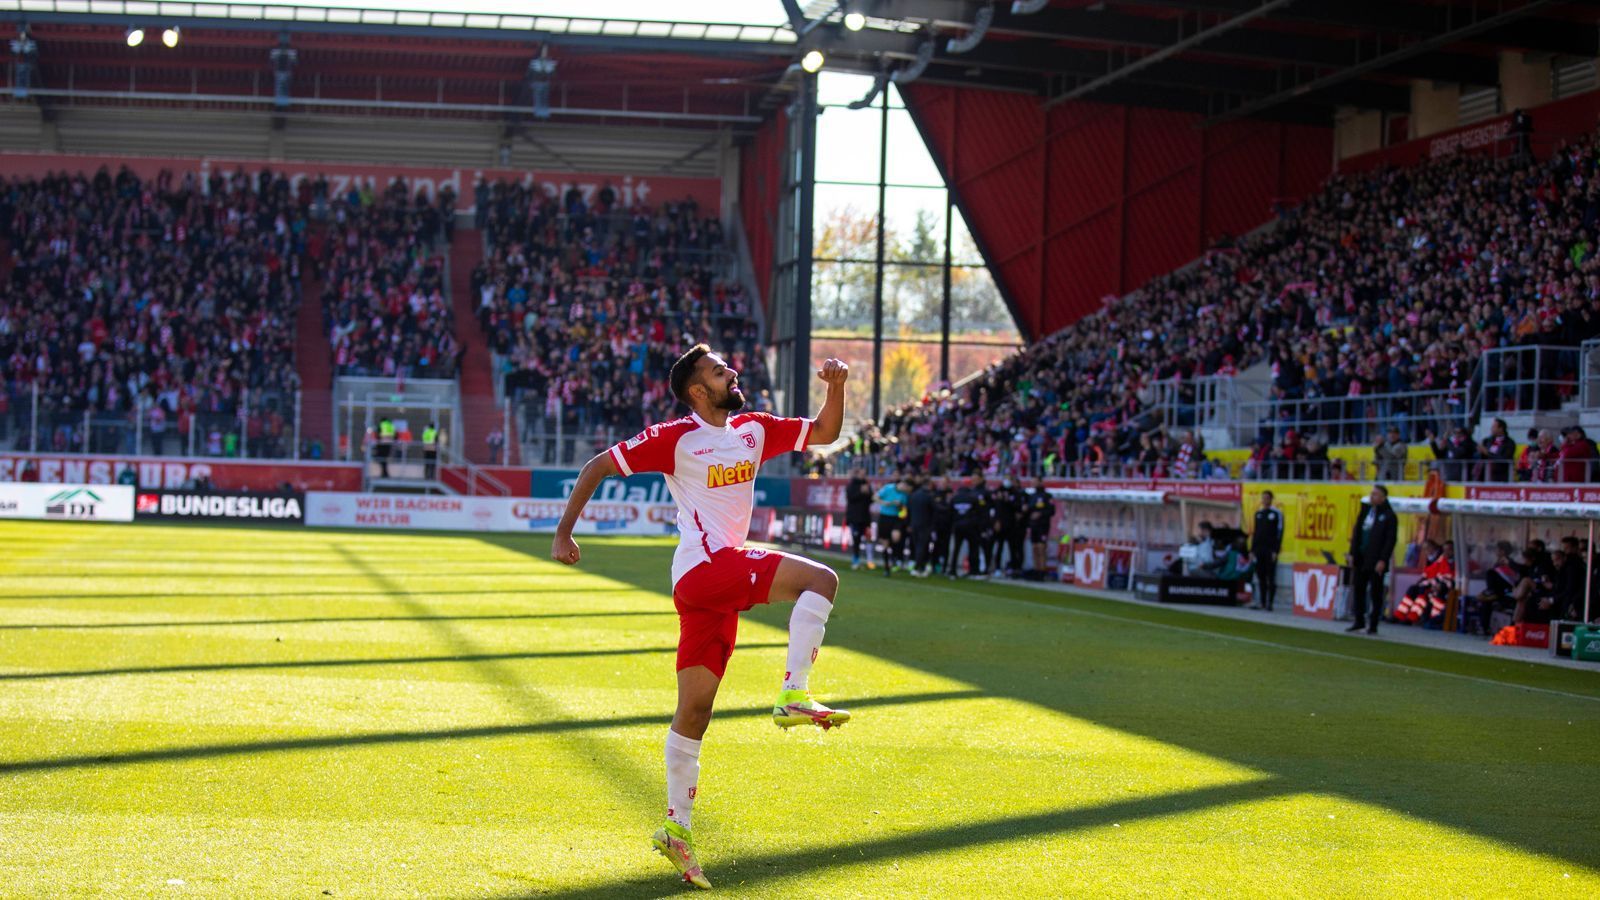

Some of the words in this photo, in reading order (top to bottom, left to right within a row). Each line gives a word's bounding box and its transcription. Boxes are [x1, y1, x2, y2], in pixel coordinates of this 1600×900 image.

[161, 494, 301, 518] BUNDESLIGA
[355, 497, 391, 509] WIR
[394, 499, 463, 512] BACKEN
[355, 512, 411, 525] NATUR
